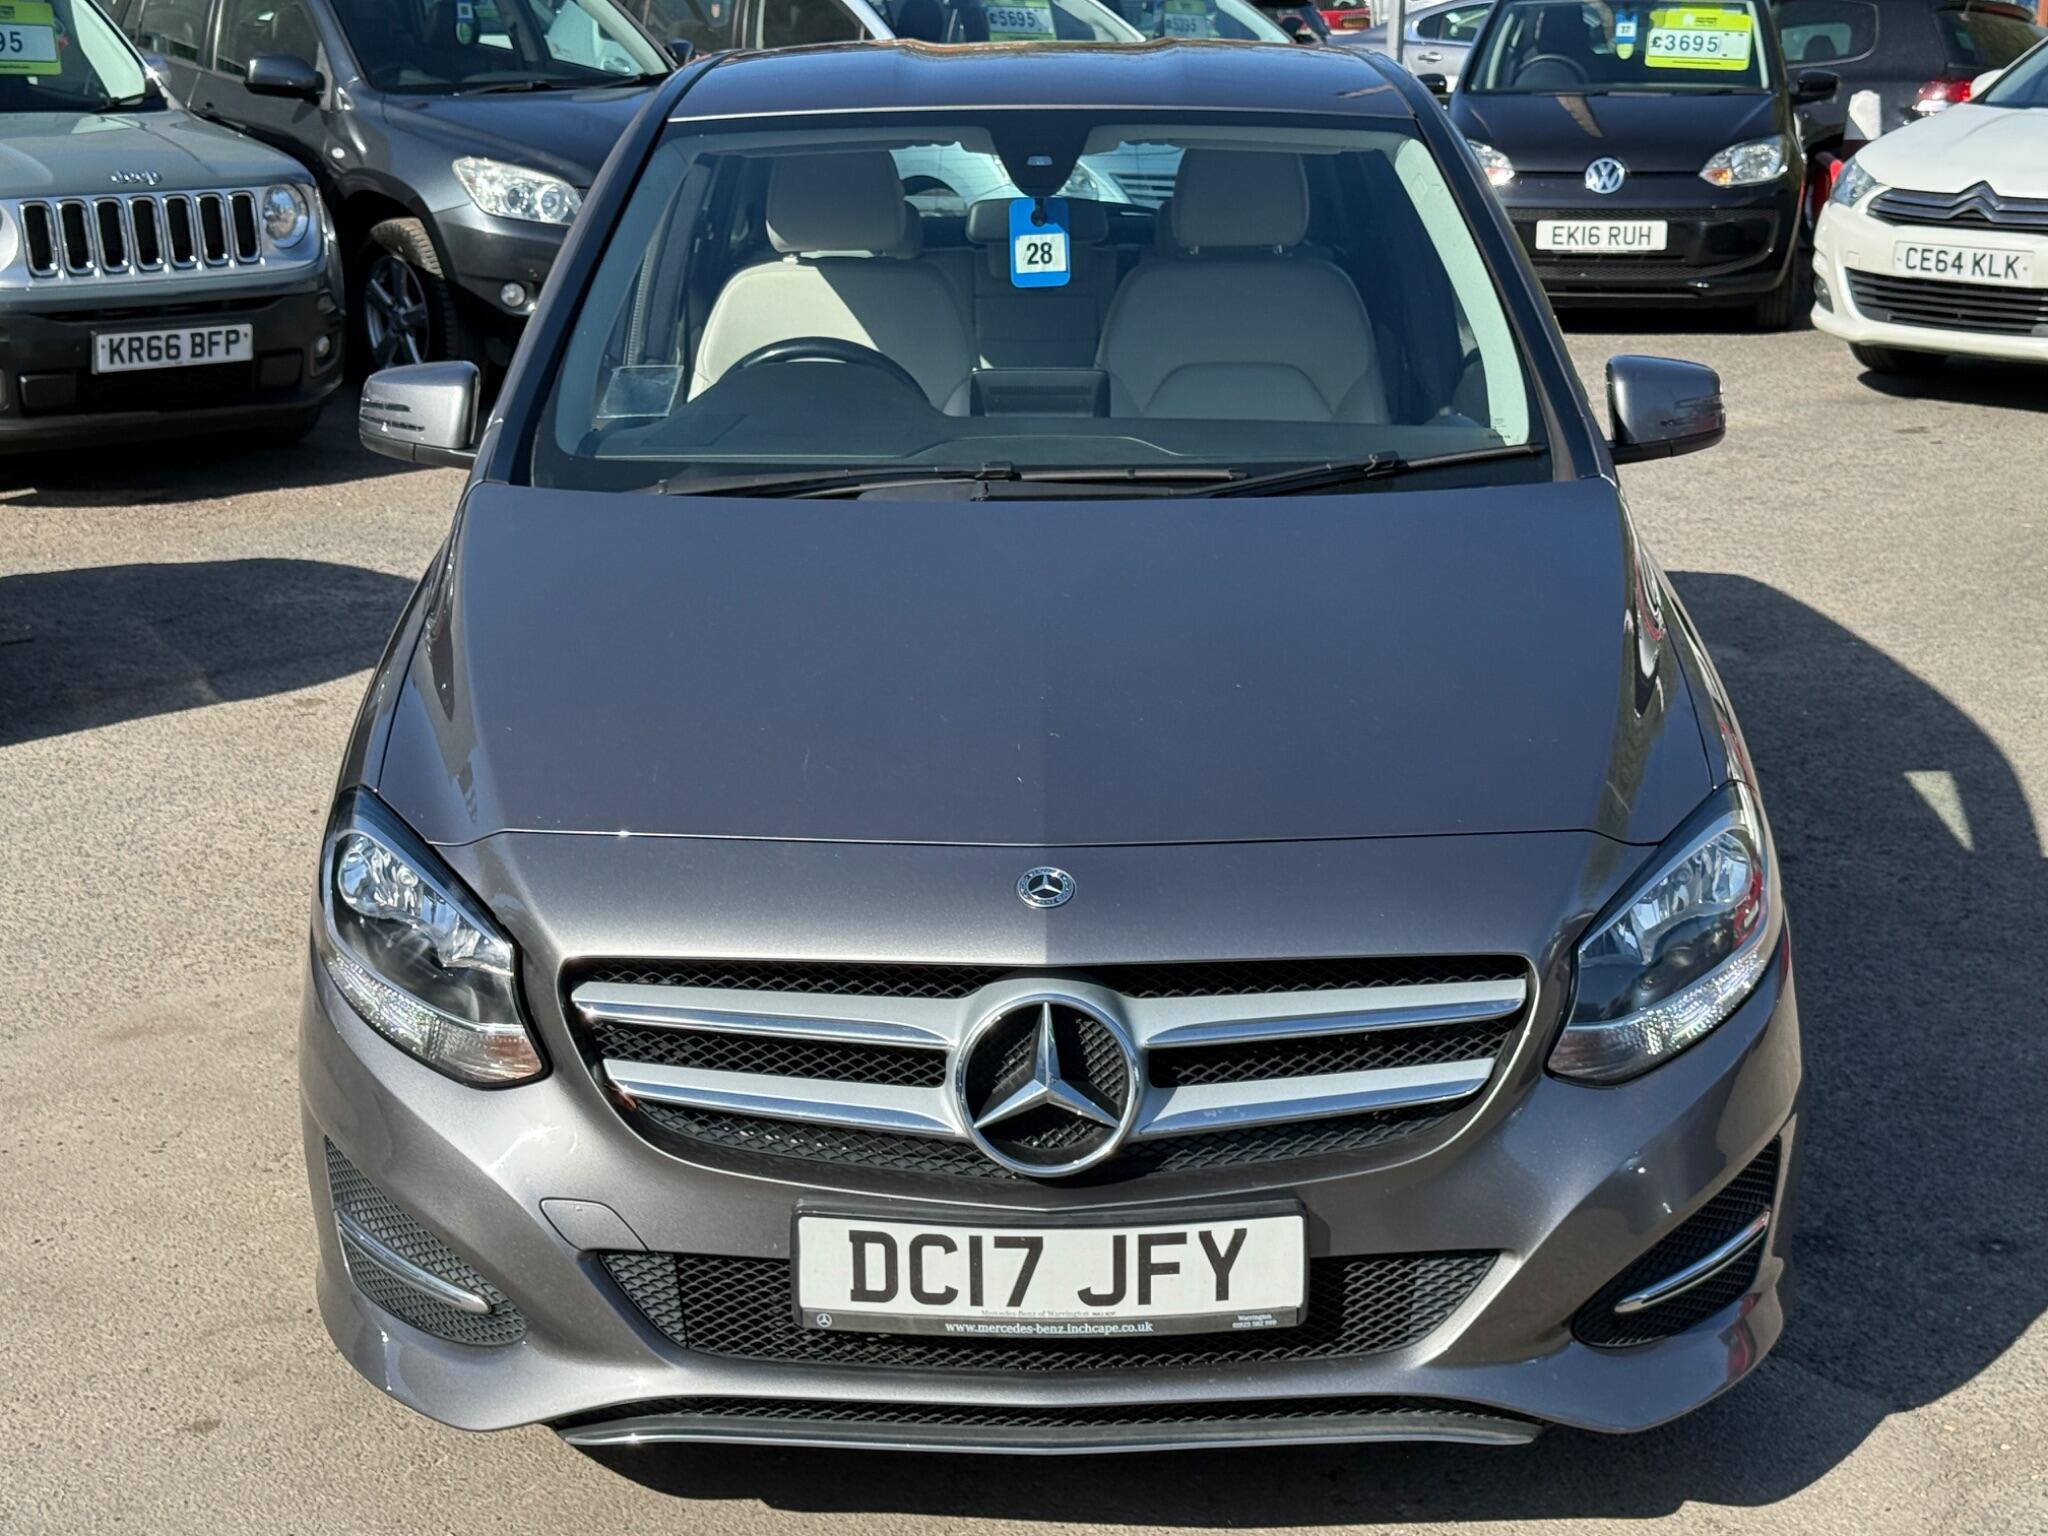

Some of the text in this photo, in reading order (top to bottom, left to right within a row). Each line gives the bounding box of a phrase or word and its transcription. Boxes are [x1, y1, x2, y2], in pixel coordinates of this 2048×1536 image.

[1651, 34, 1719, 53] £3695
[1552, 225, 1652, 246] EK16 RUH
[1026, 242, 1053, 265] 28
[1905, 247, 2020, 280] CE64 KLK
[108, 329, 240, 365] KR66 BFP
[848, 1227, 1248, 1307] DC17 JFY
[945, 1321, 1154, 1335] www.mercedes-benz.inchcape.co.uk
